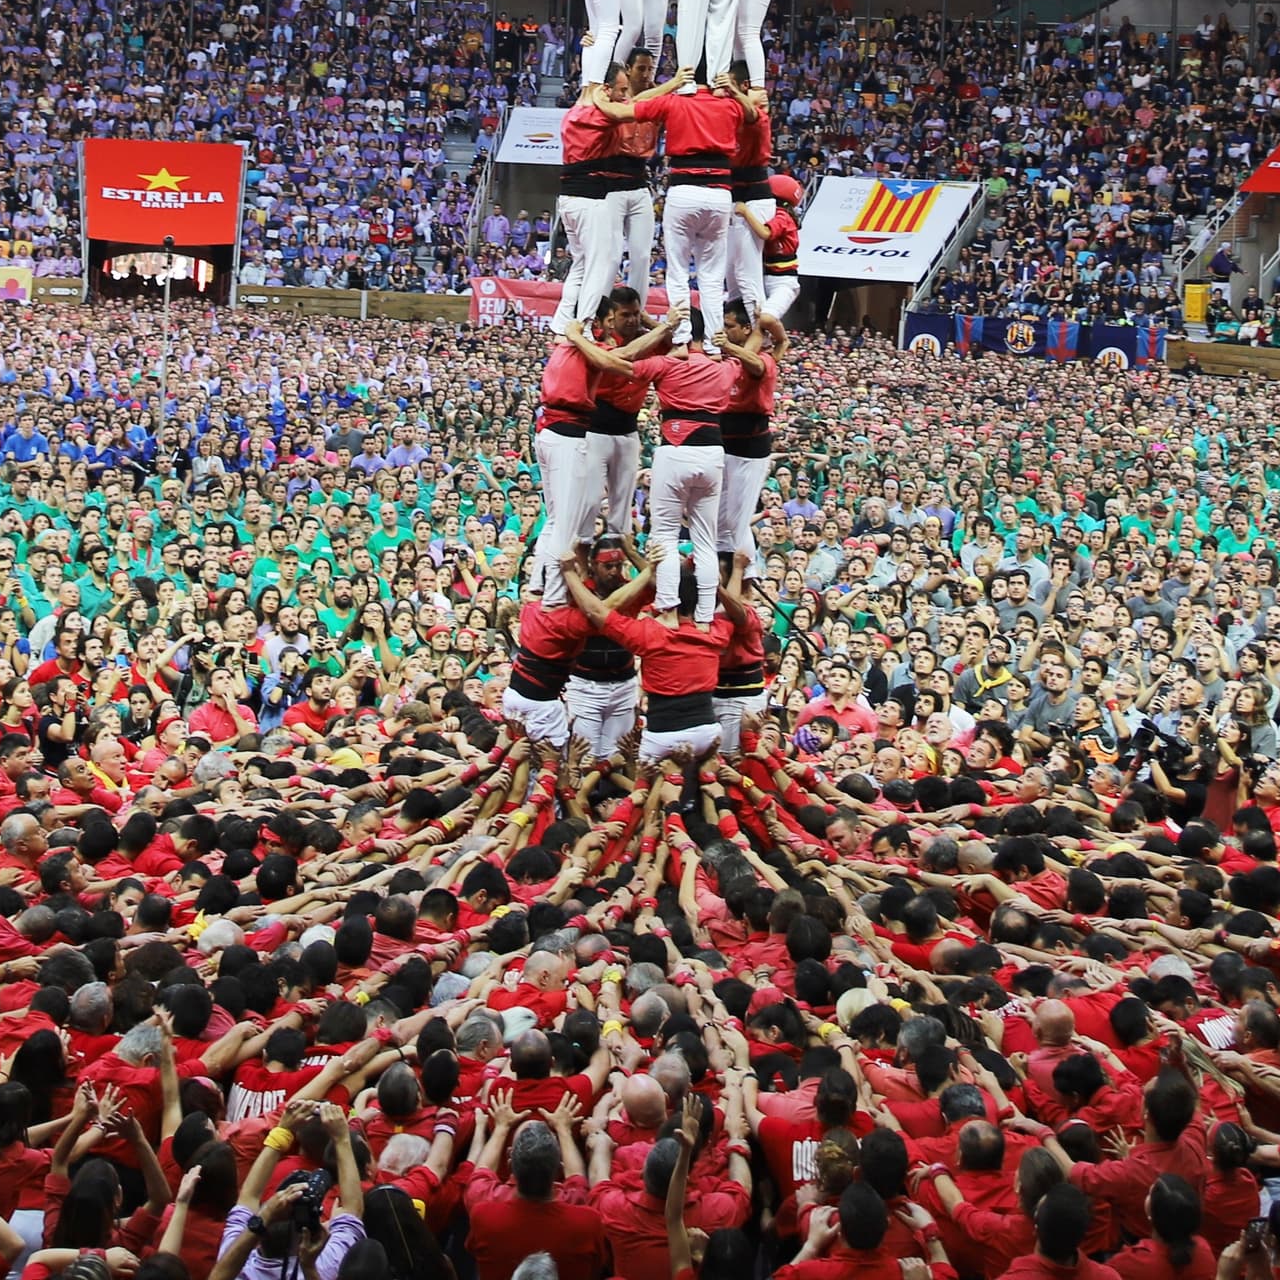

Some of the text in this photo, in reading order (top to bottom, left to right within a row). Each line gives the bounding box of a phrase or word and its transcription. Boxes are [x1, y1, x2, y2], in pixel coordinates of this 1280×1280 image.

[101, 187, 224, 203] ESTRELLA
[141, 201, 185, 209] DAMM
[813, 245, 913, 258] REPSOL
